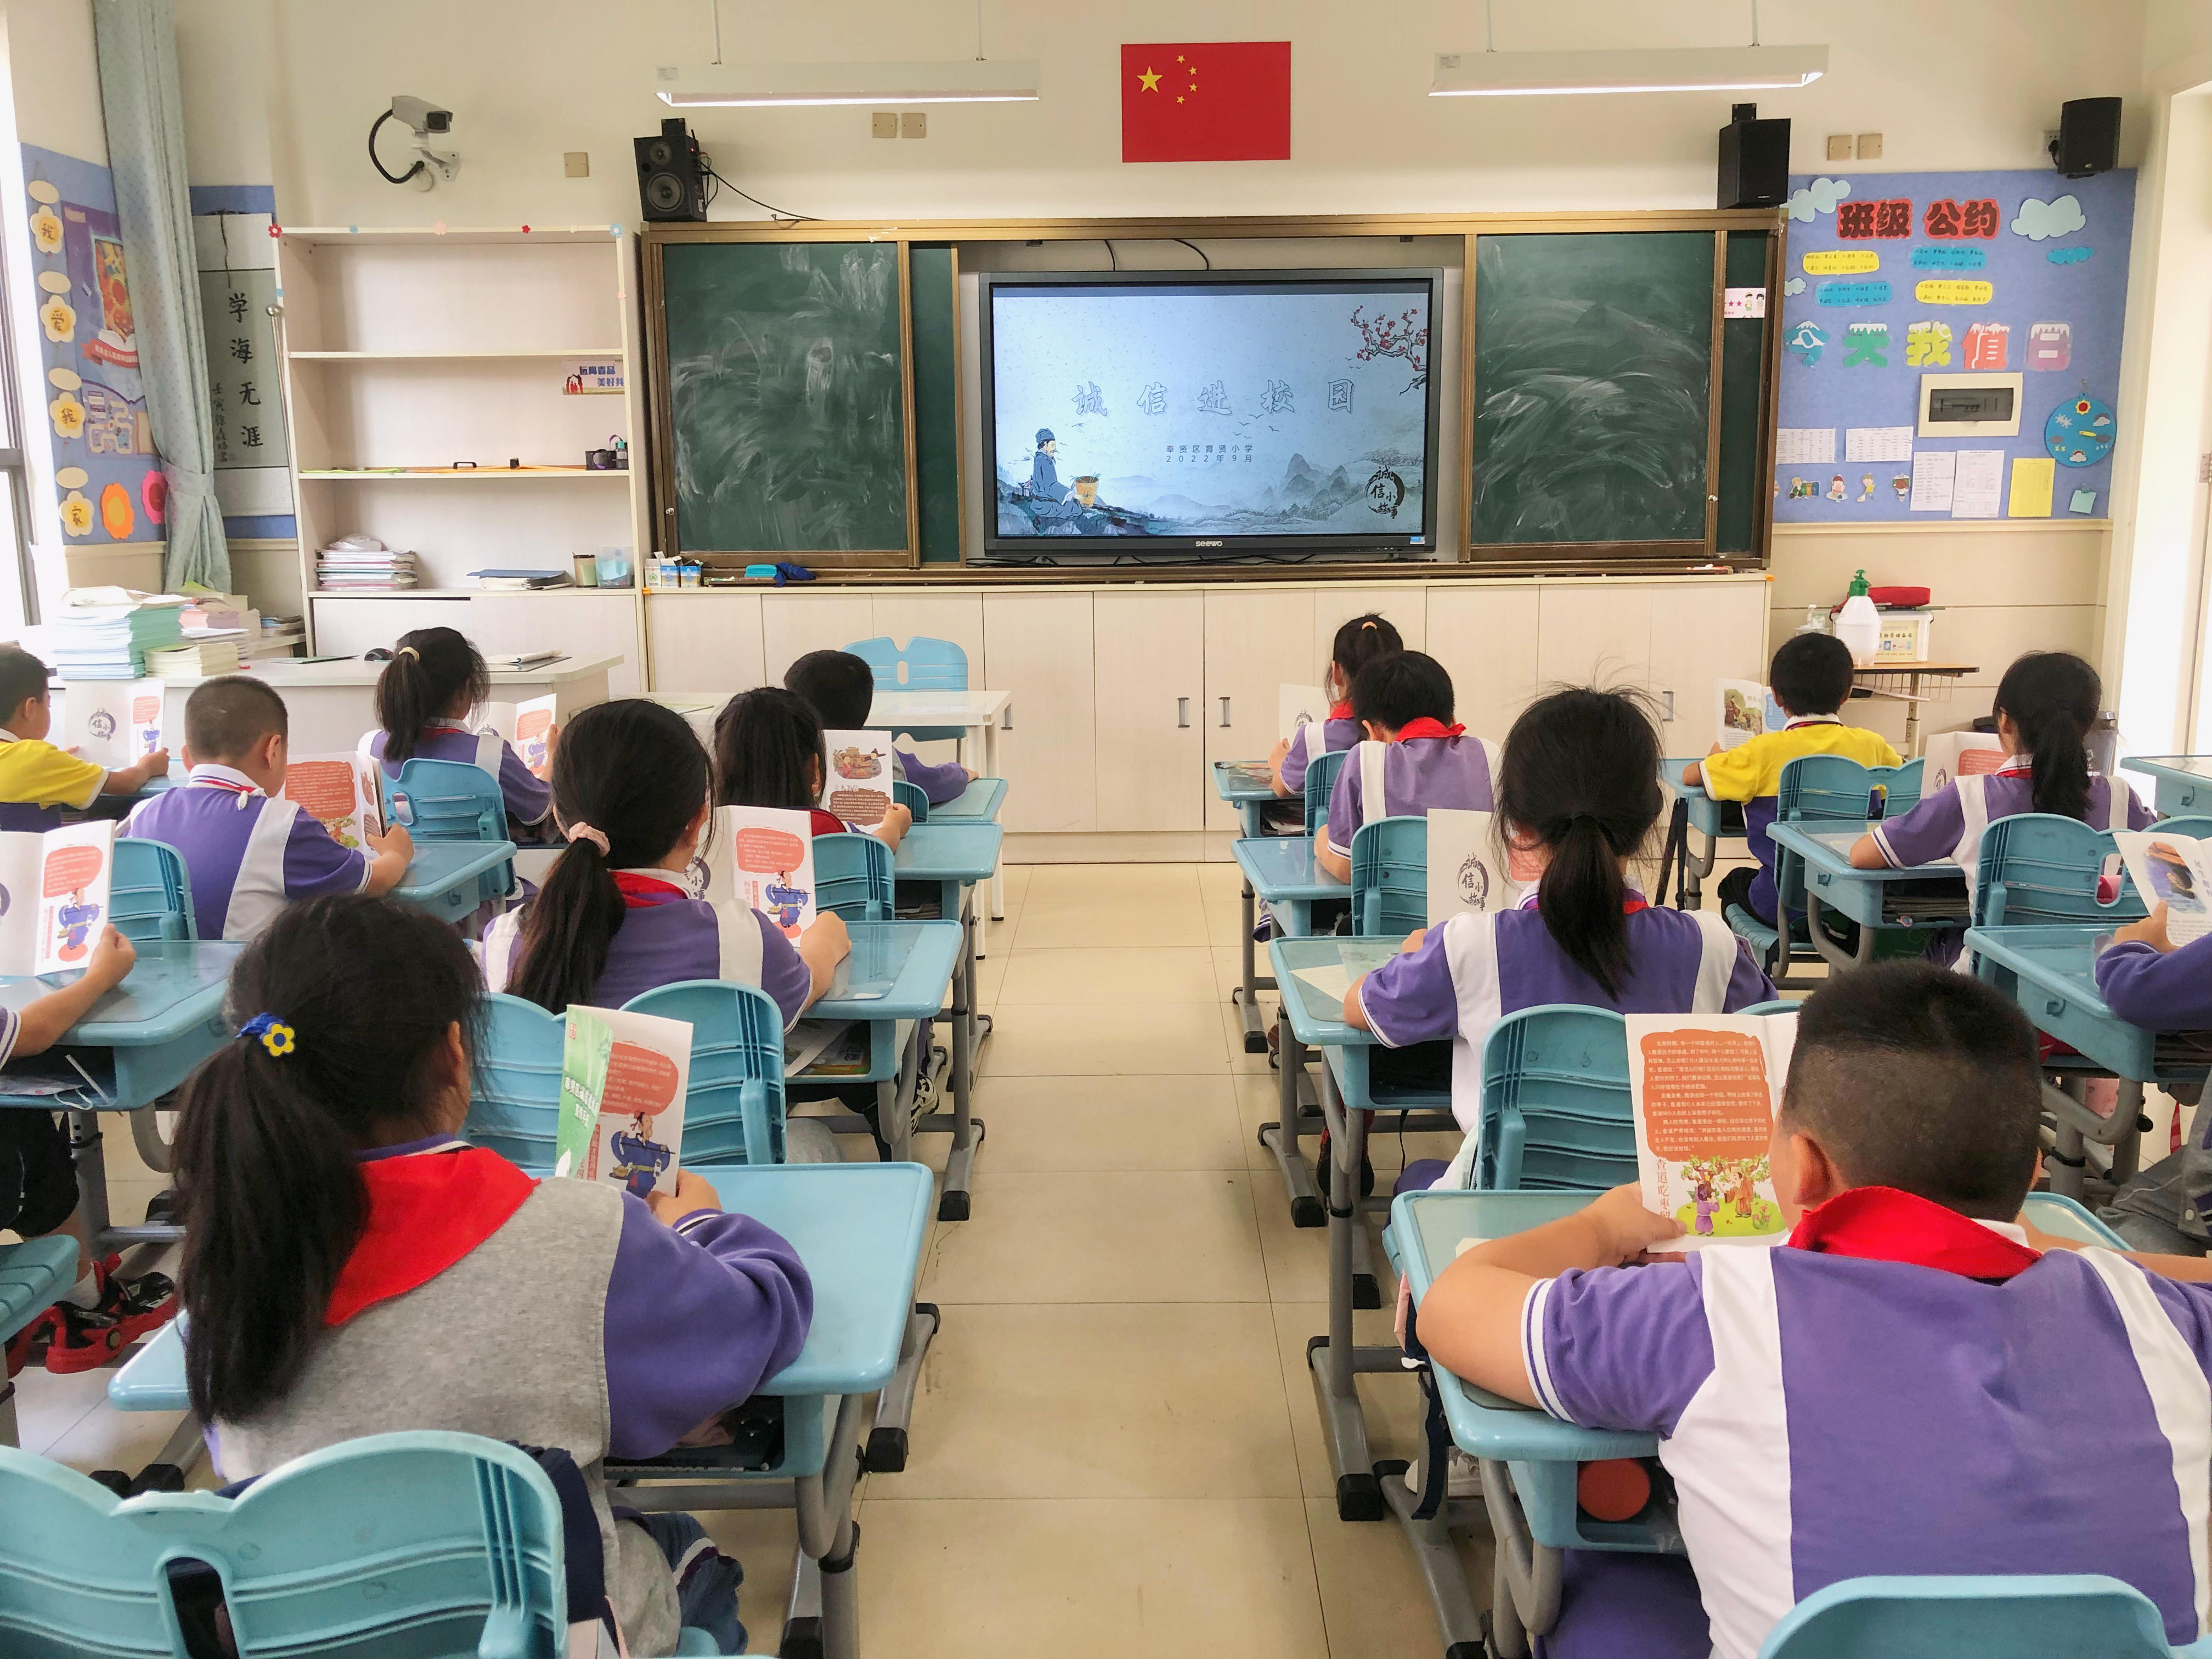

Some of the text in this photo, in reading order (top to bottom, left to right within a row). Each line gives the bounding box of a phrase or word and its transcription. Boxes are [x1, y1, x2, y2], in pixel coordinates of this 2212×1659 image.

[1839, 201, 1997, 238] 班级 公约
[1784, 320, 2073, 371] 今天我值日
[228, 292, 264, 448] 学海无涯
[1071, 380, 1355, 416] 诚信进校园
[1166, 444, 1253, 453] 奉贤区育贤小学
[1166, 455, 1252, 463] 2022年9月
